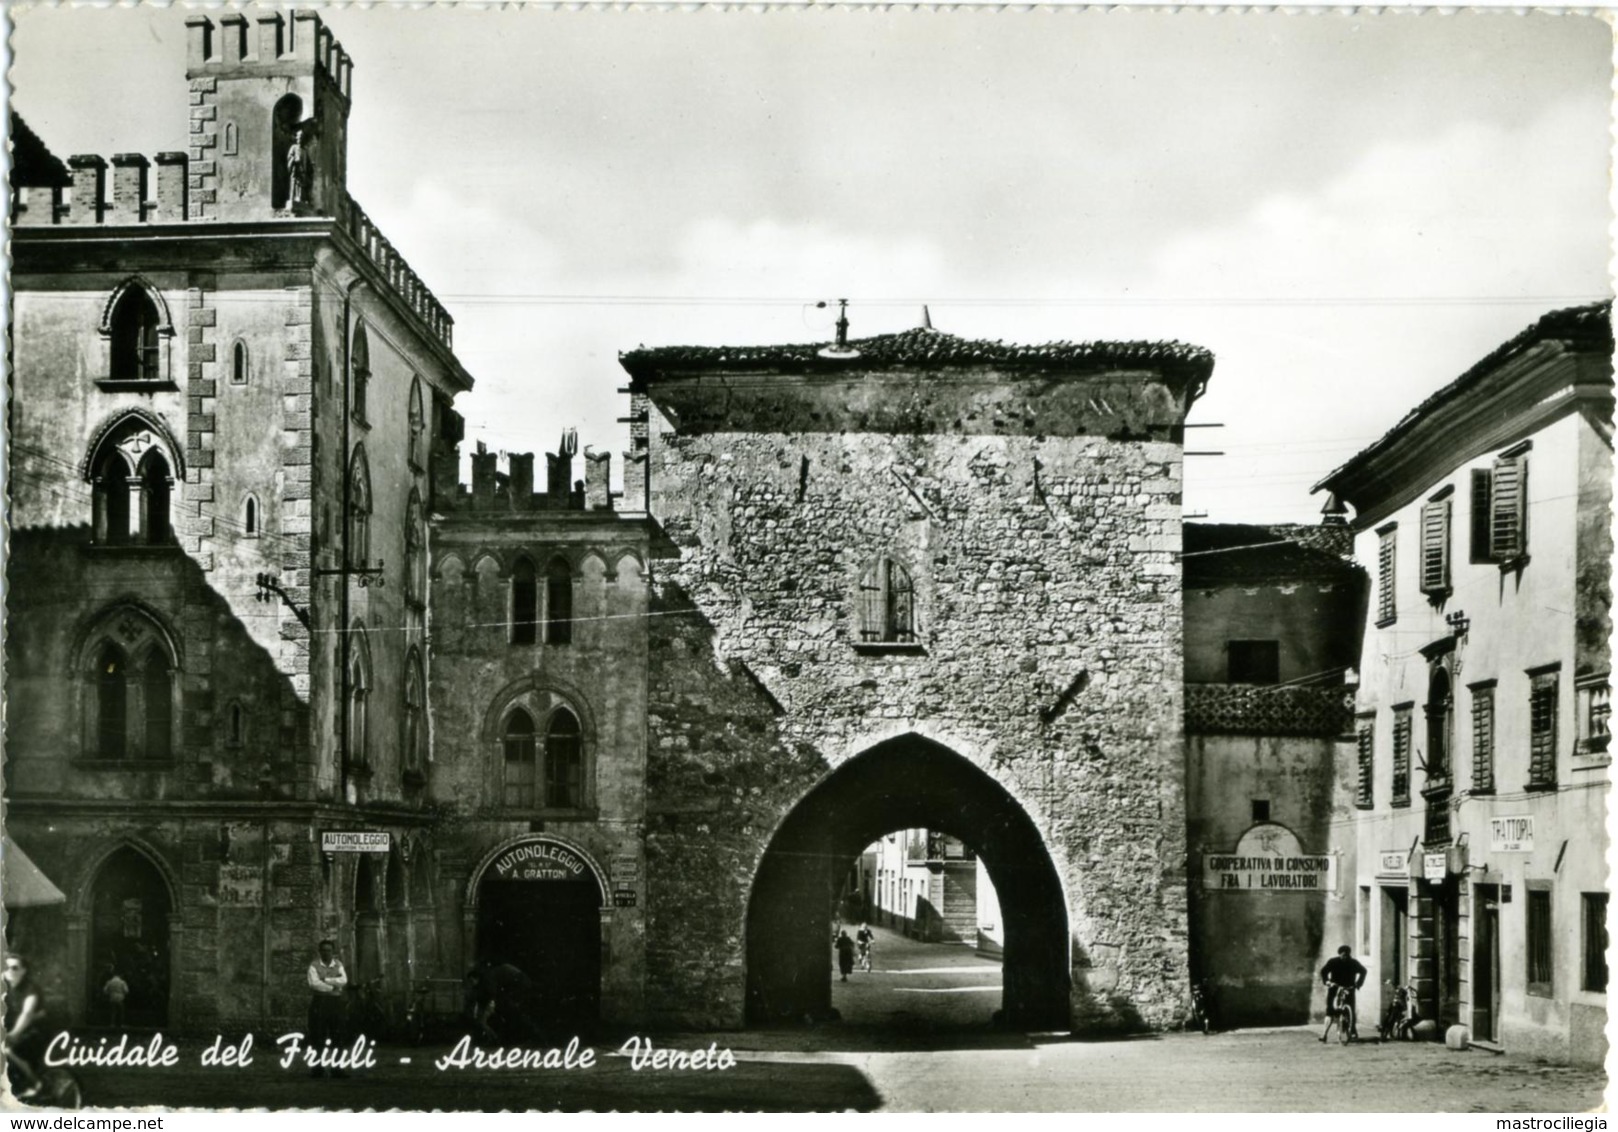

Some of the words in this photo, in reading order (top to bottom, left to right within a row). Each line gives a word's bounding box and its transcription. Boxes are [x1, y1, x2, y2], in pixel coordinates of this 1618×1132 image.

[324, 834, 388, 845] AUTONOLEGGIO
[495, 844, 585, 876] AUTONOLEGGIO
[1210, 857, 1272, 871] COOPERATIVA
[1274, 857, 1284, 871] DI
[1286, 857, 1330, 872] CONSUMO
[524, 869, 567, 878] GRATTONI
[1221, 873, 1240, 888] FRA
[1247, 874, 1252, 888] I
[1261, 874, 1318, 888] LAVORATORI
